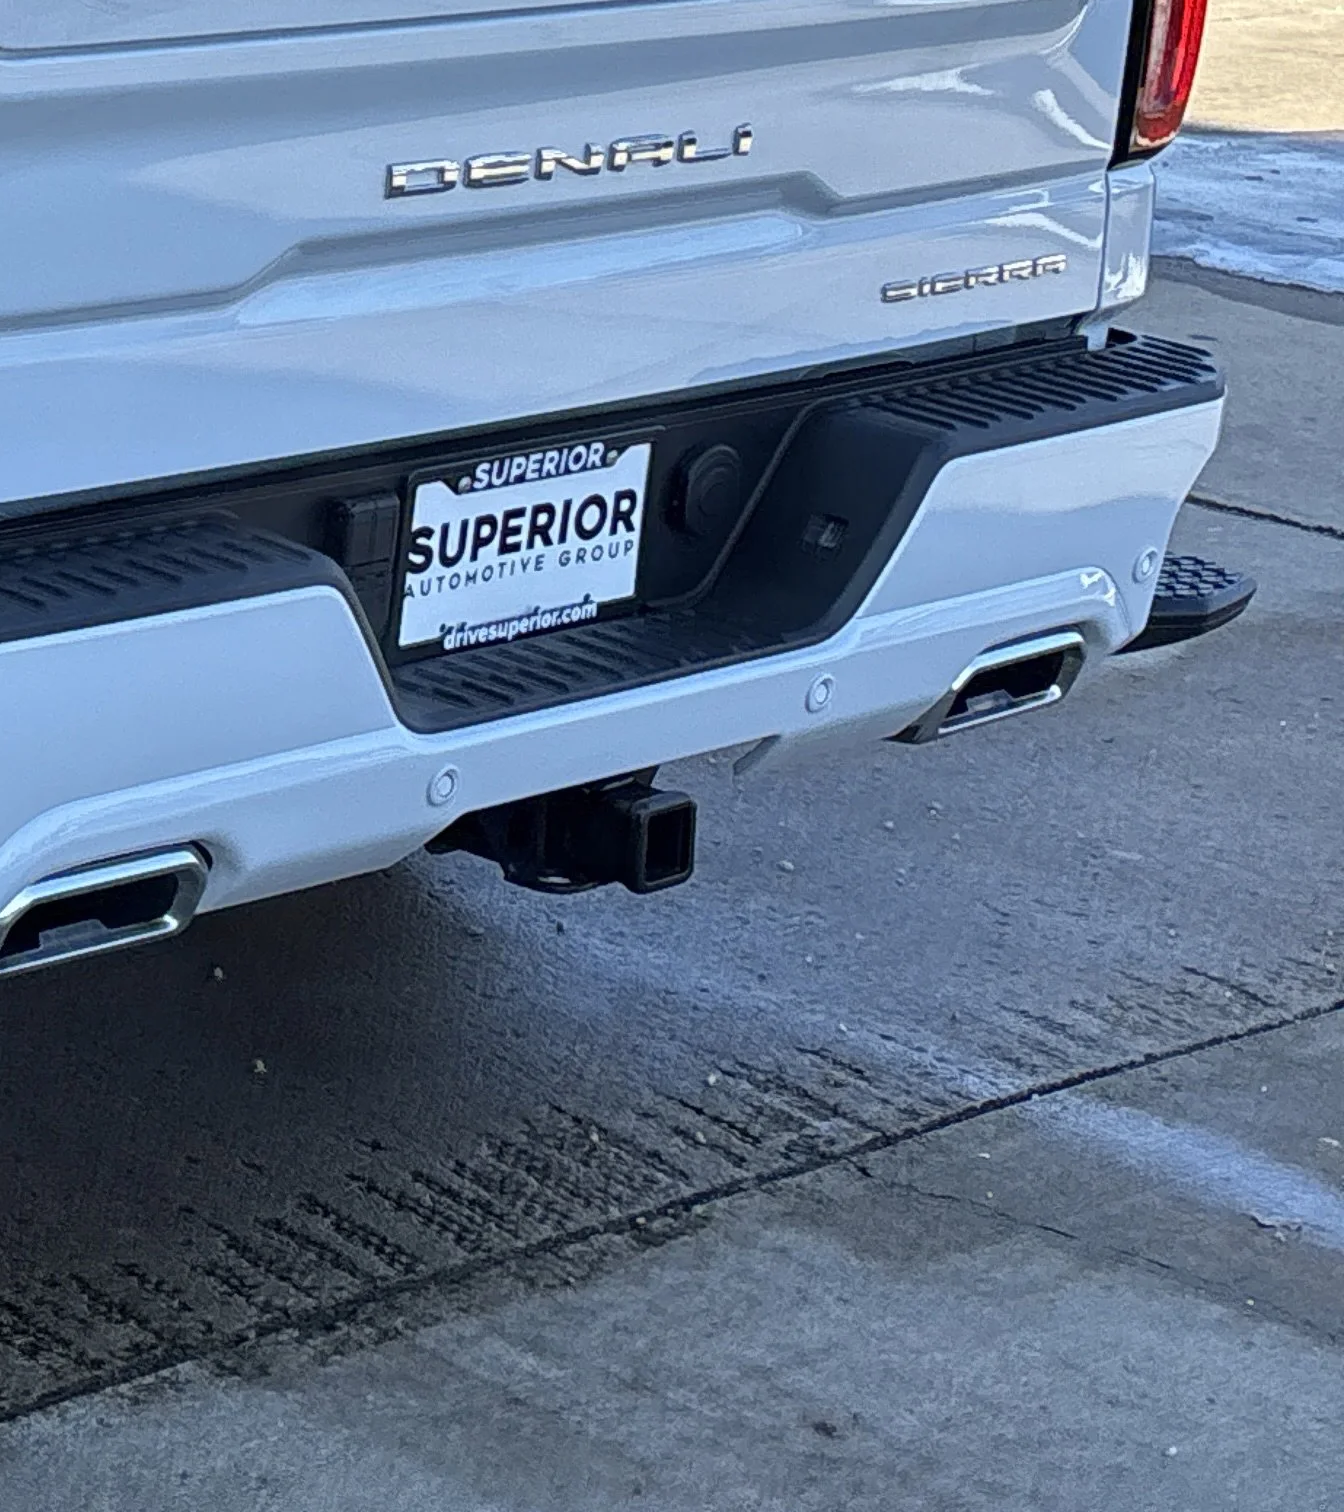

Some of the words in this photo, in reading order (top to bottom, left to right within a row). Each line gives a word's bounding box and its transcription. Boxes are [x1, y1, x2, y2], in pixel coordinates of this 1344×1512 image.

[384, 122, 753, 200] DENALI
[881, 252, 1067, 303] SIERRA
[473, 442, 605, 488] SUPERIOR
[408, 488, 638, 574] SUPERIOR
[403, 553, 546, 598] AUTOMOTIVE
[558, 538, 635, 568] GROUP
[442, 598, 598, 650] drivesuperior.com
